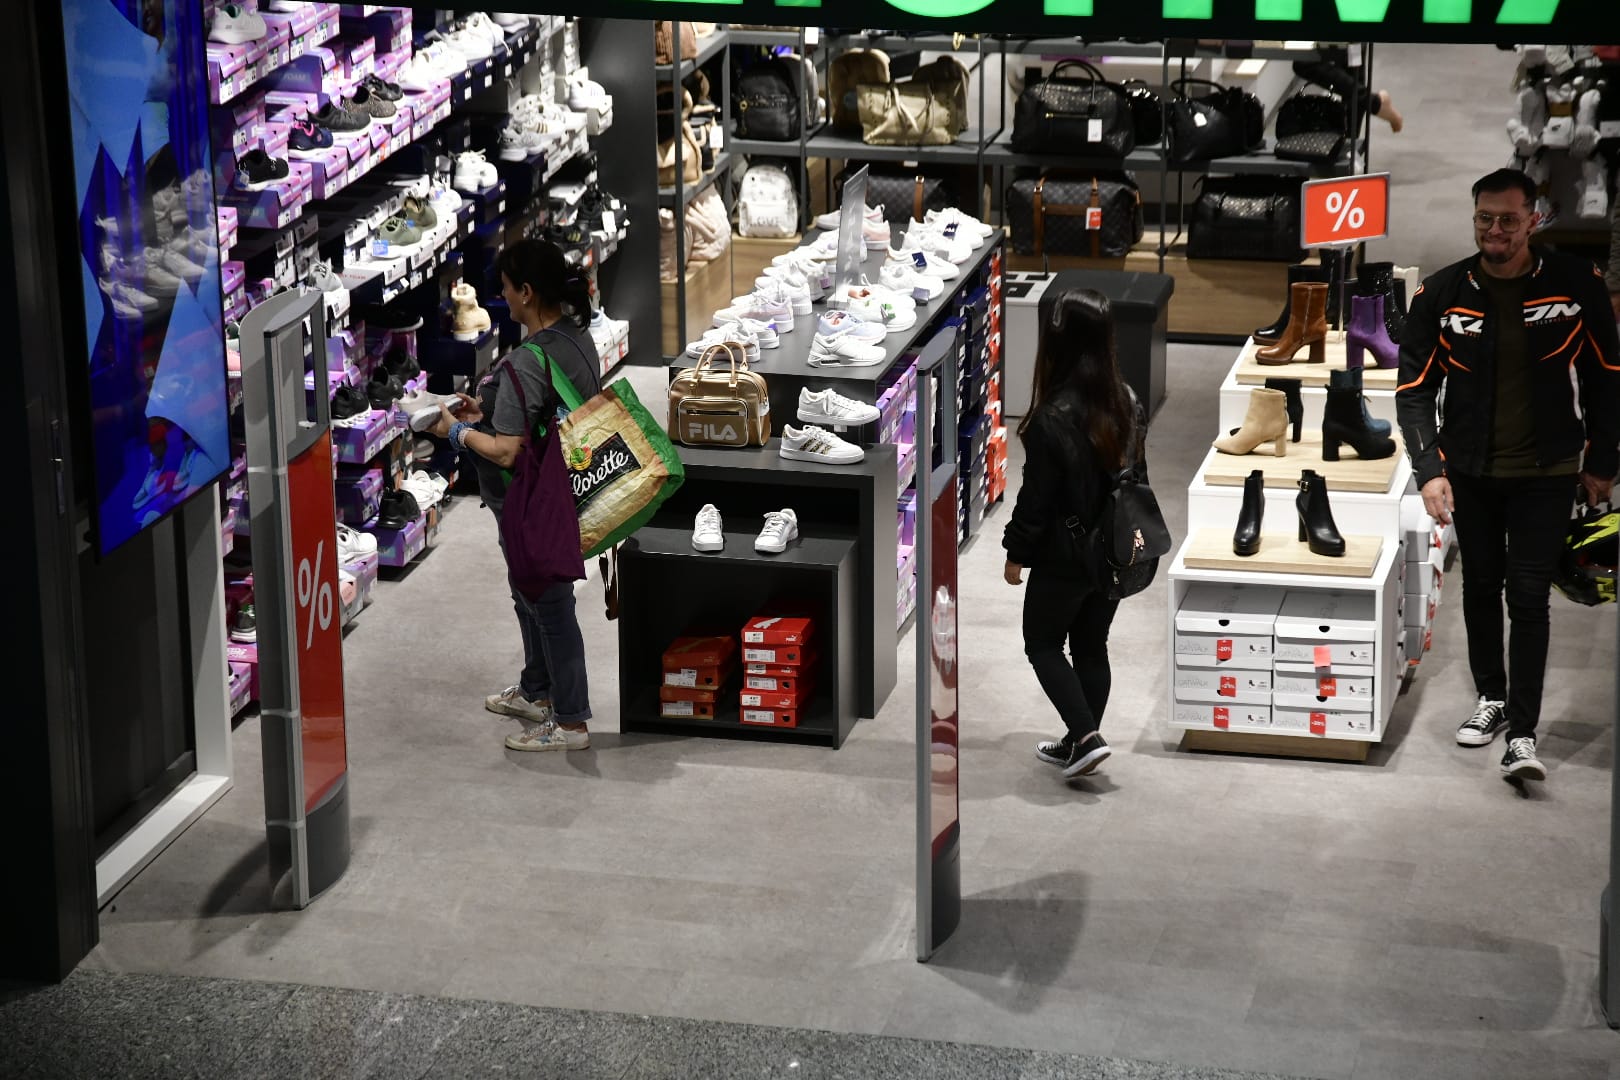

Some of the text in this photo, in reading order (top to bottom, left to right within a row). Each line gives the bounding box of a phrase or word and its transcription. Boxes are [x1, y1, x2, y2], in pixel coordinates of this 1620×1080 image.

[1325, 189, 1365, 232] %
[687, 422, 739, 441] FILA
[568, 449, 629, 498] lorette
[298, 539, 333, 651] %
